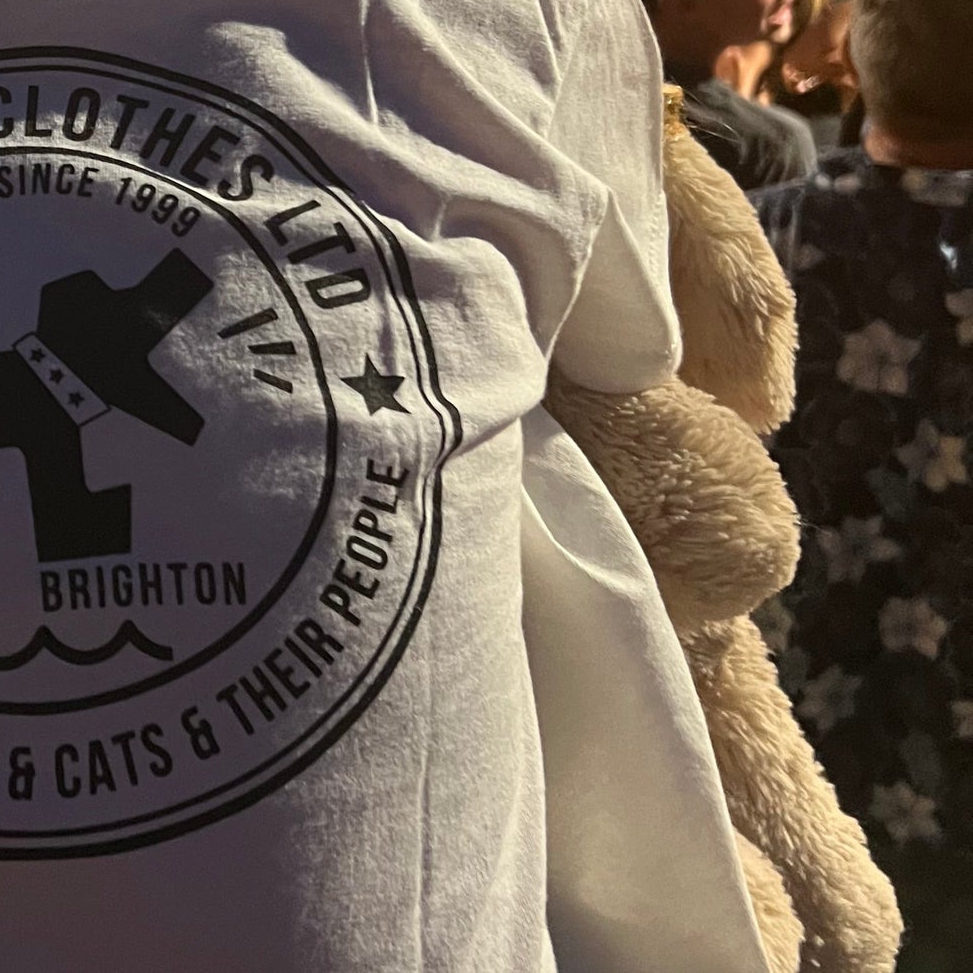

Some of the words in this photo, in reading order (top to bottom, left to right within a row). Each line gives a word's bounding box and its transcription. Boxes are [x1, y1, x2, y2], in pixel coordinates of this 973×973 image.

[116, 177, 200, 237] 1999
[265, 200, 371, 309] LTD
[40, 562, 246, 612] BRIGHTON
[8, 747, 35, 801] &
[55, 723, 173, 799] CATS
[181, 705, 220, 761] &
[216, 618, 344, 735] THEIR
[319, 459, 410, 626] PEOPLE
